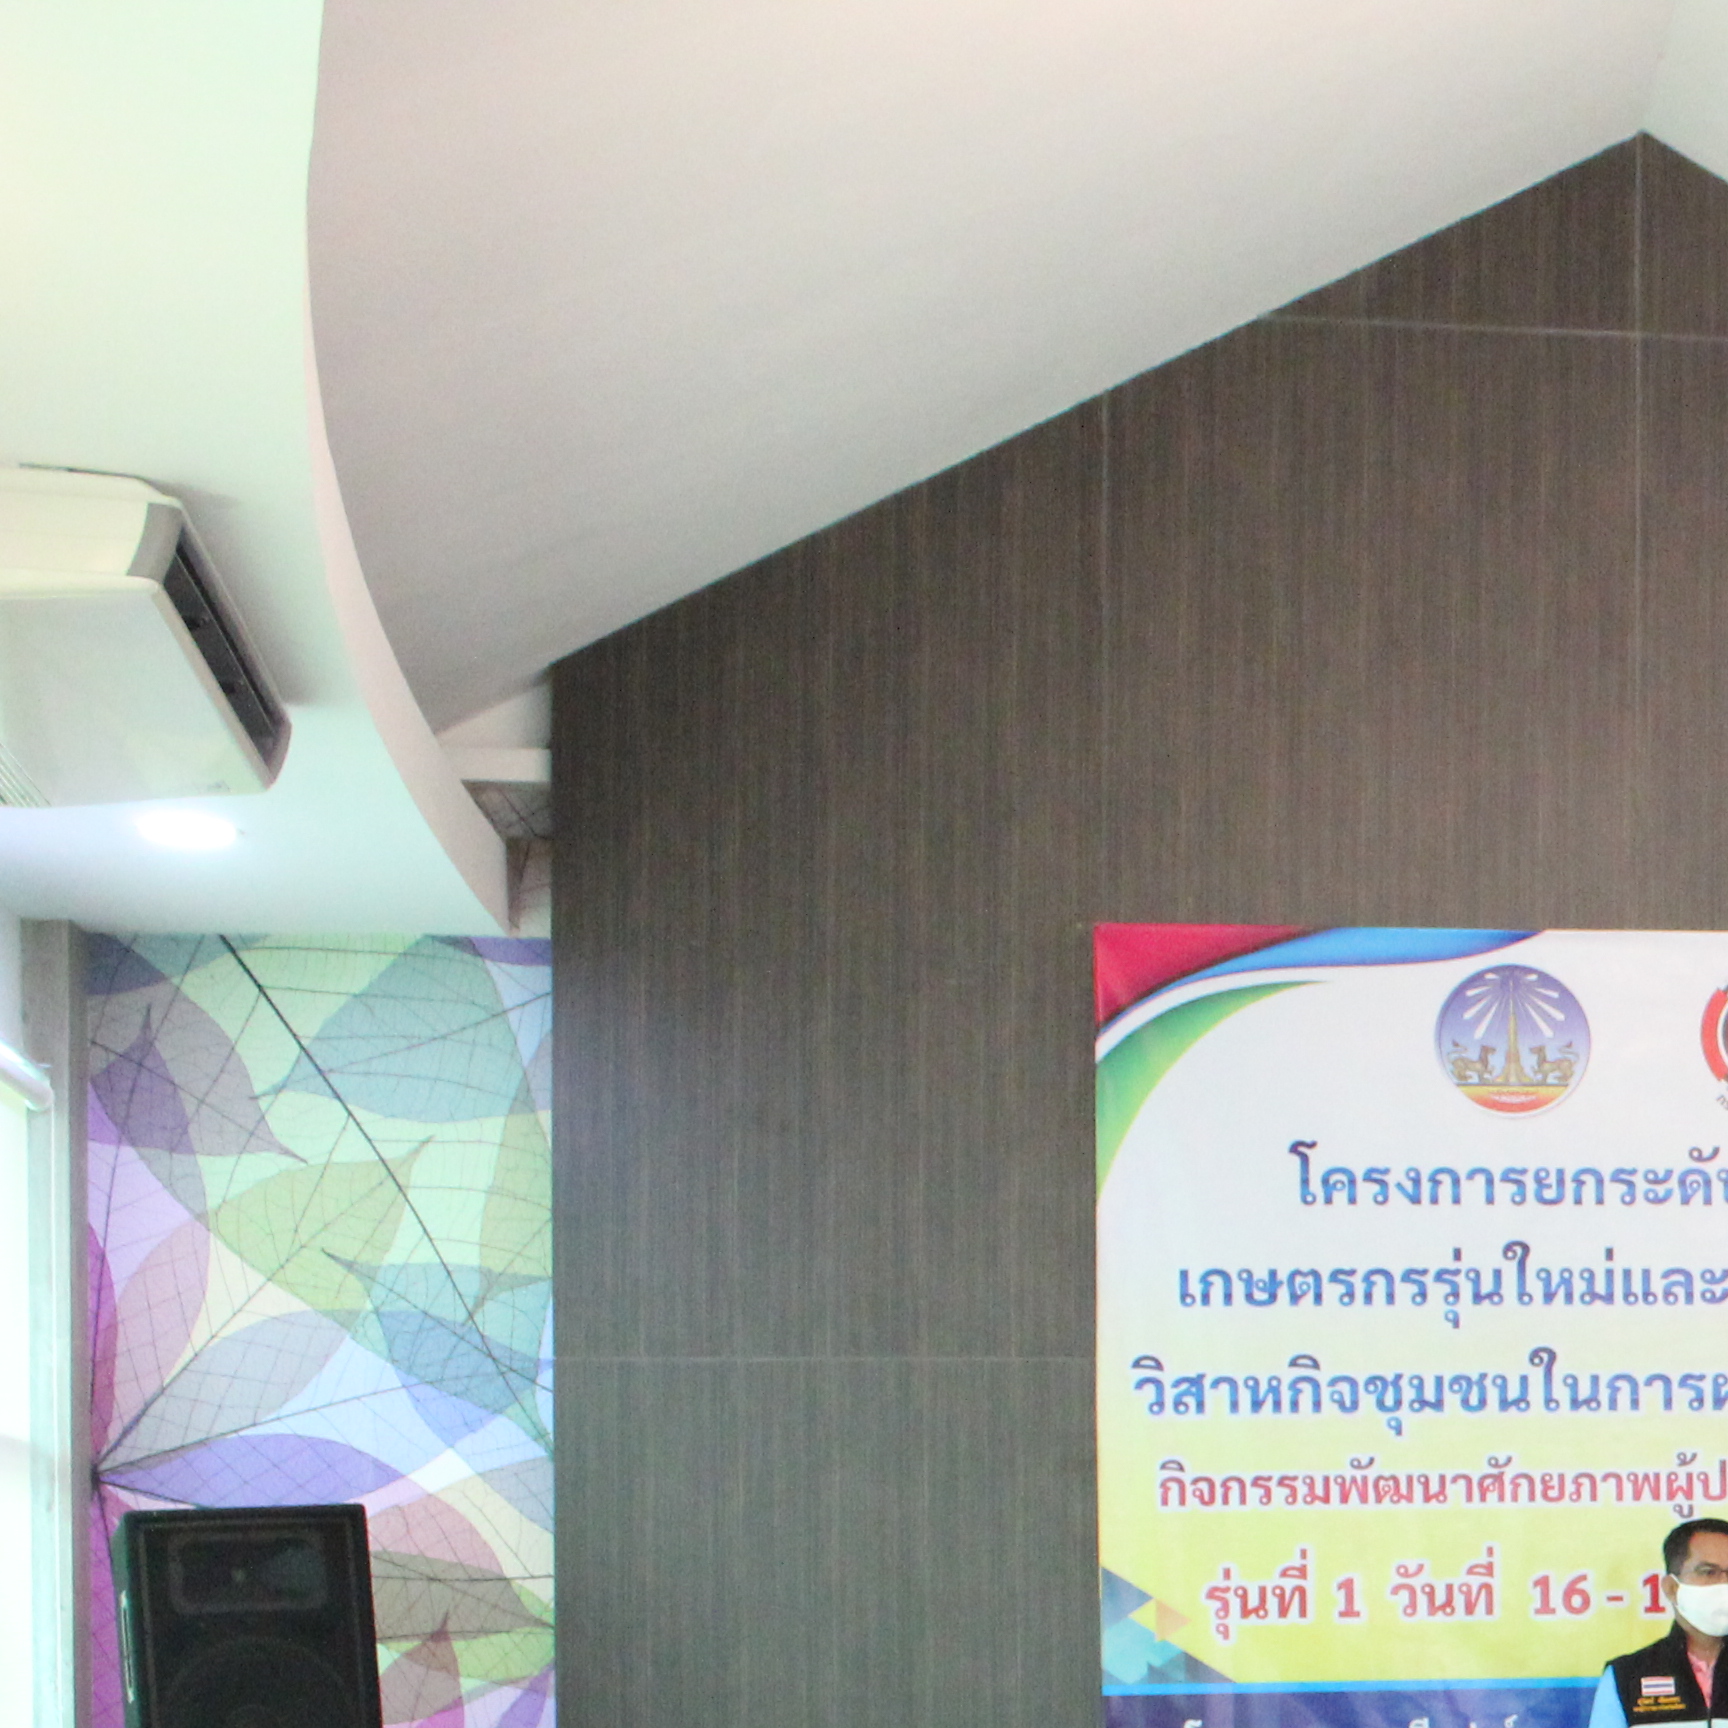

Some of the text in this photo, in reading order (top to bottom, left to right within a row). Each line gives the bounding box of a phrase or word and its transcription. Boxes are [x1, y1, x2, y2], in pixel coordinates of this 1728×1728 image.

[1206, 1547, 1308, 1640] รุ่นที่
[1336, 1577, 1361, 1617] 1
[1389, 1546, 1495, 1616] วันที่
[1532, 1574, 1592, 1615] 16
[1643, 1573, 1667, 1613] 1
